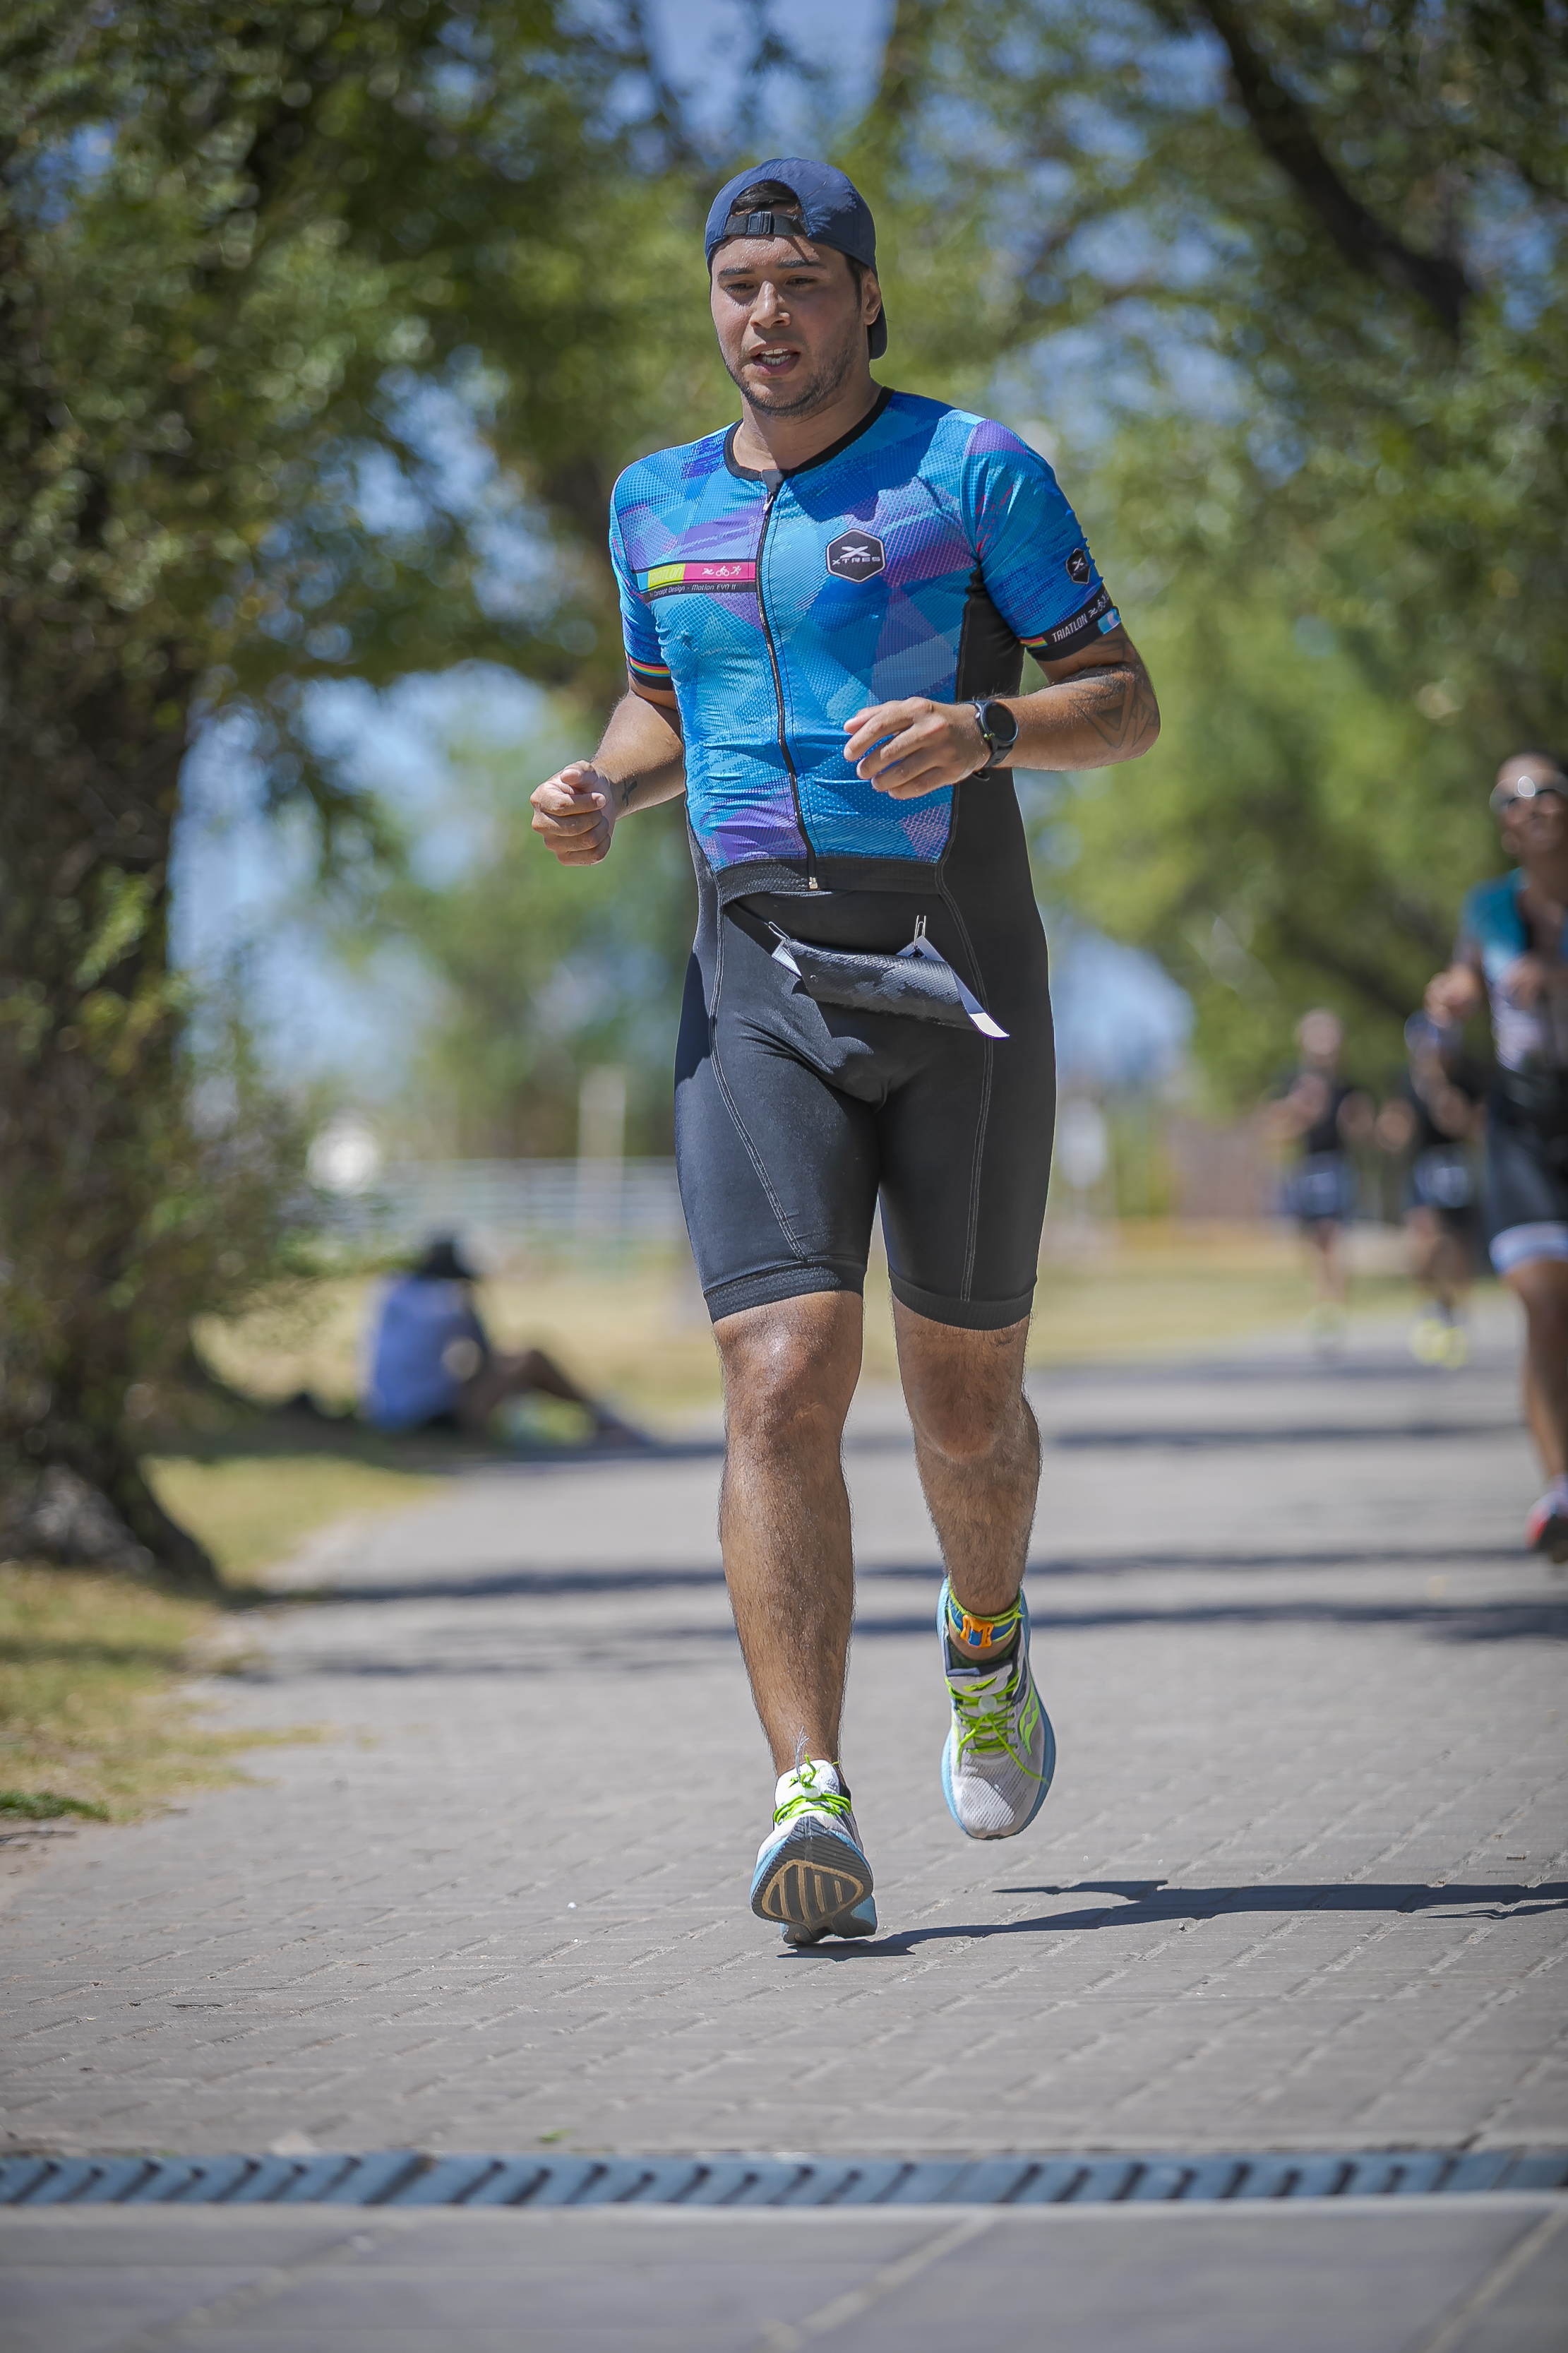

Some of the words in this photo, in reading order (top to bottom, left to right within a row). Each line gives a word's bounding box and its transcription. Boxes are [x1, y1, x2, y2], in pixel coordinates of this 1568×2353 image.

[832, 556, 881, 566] XTRES
[650, 566, 683, 585] TRIATLON
[1051, 613, 1088, 643] TRIATLON
